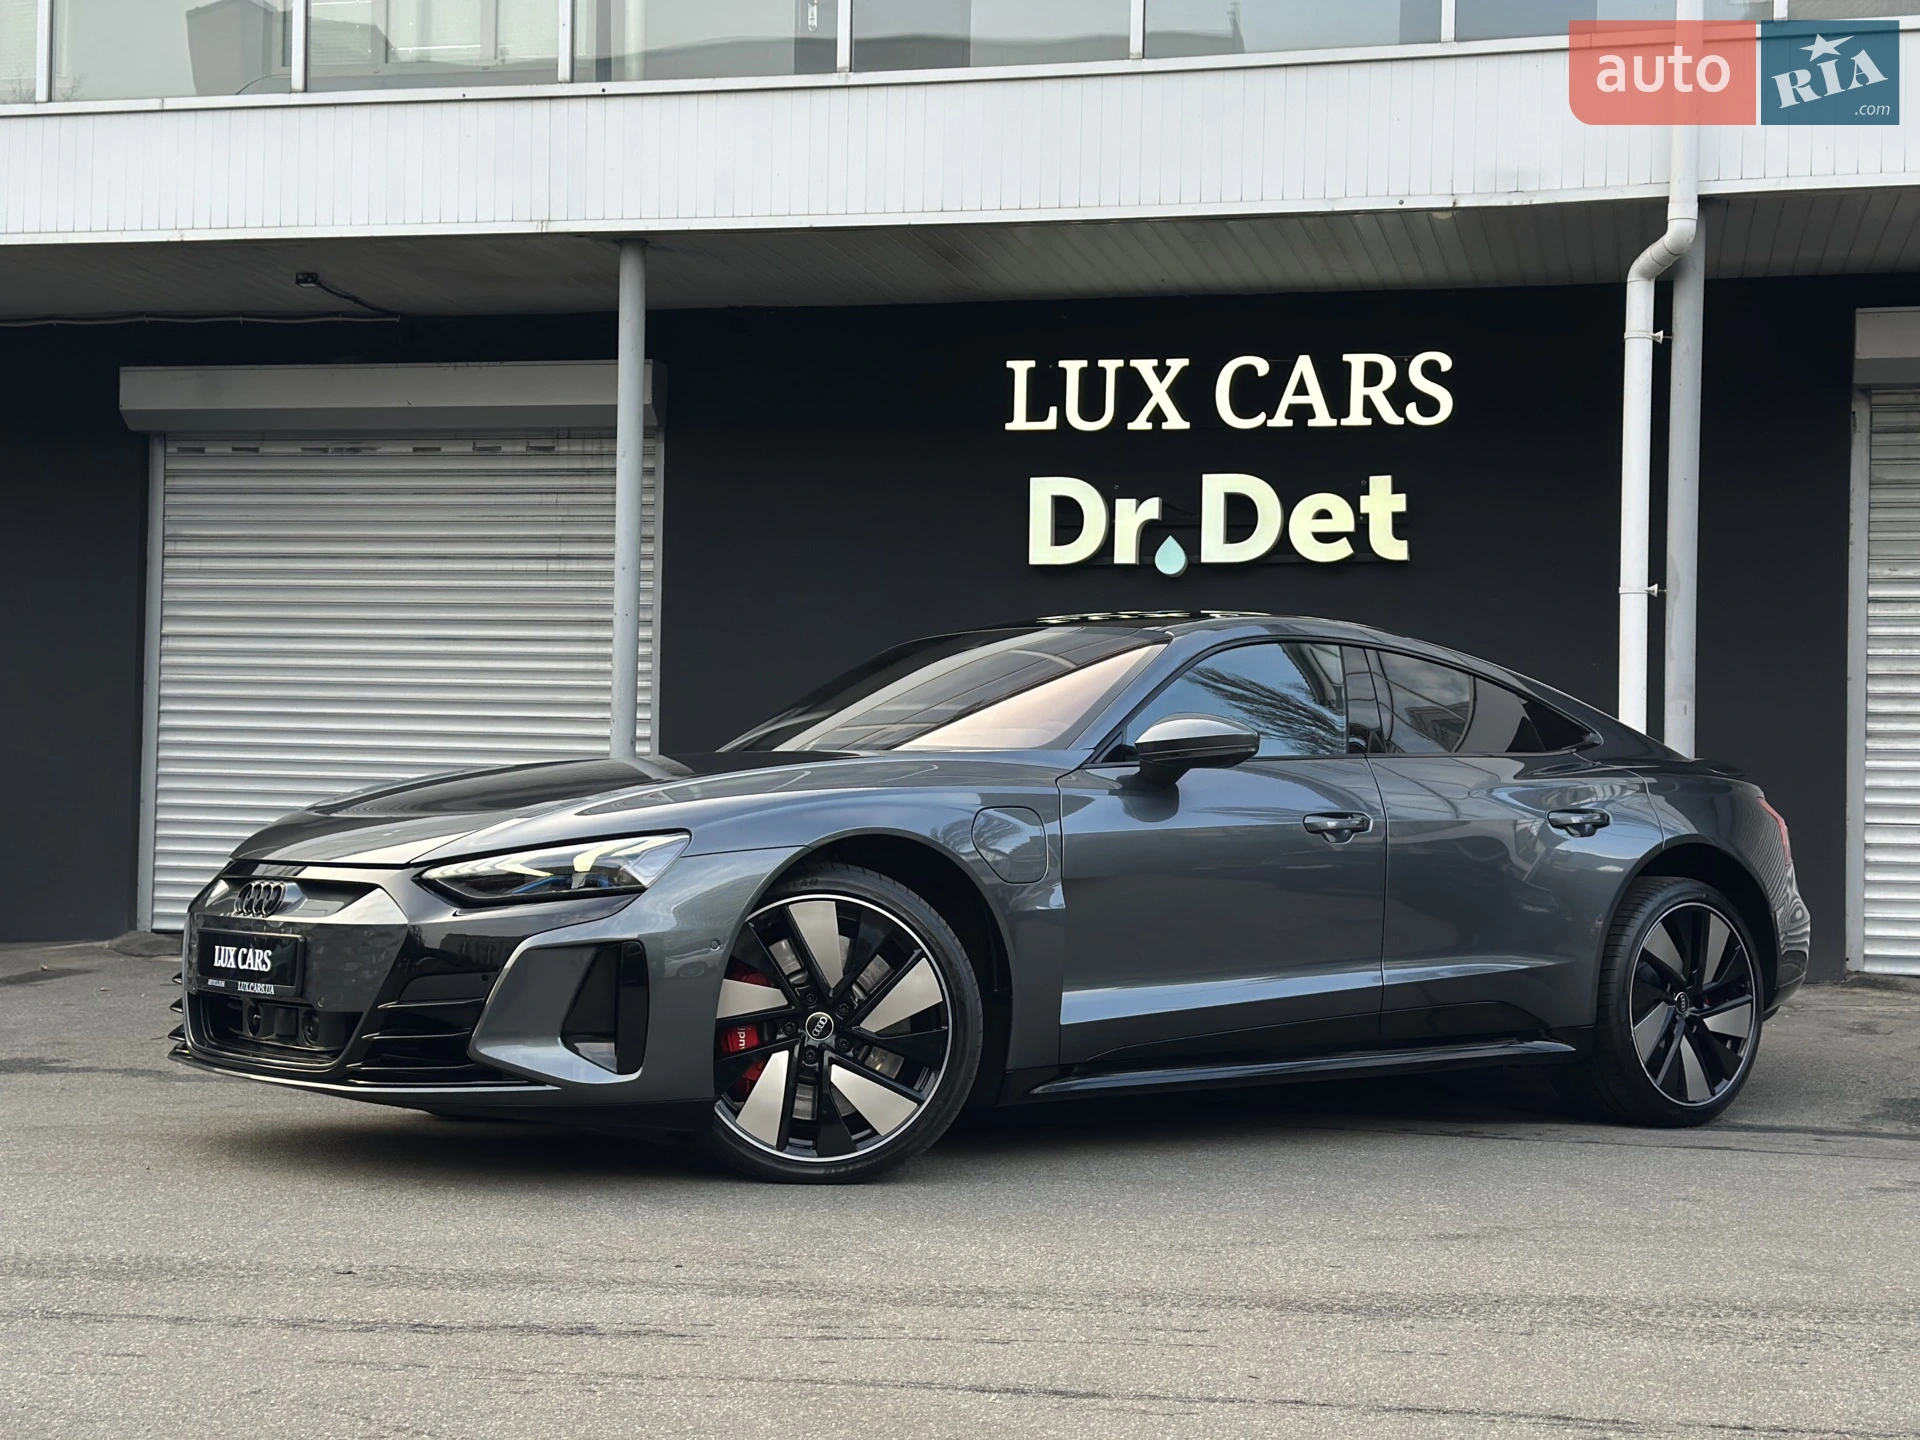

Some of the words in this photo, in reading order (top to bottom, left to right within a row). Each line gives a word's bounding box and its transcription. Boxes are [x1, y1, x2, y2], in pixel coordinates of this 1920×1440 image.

[1004, 358, 1191, 431] LUX
[1215, 351, 1454, 429] CARS
[213, 945, 238, 968] LUX
[238, 948, 272, 972] CARS
